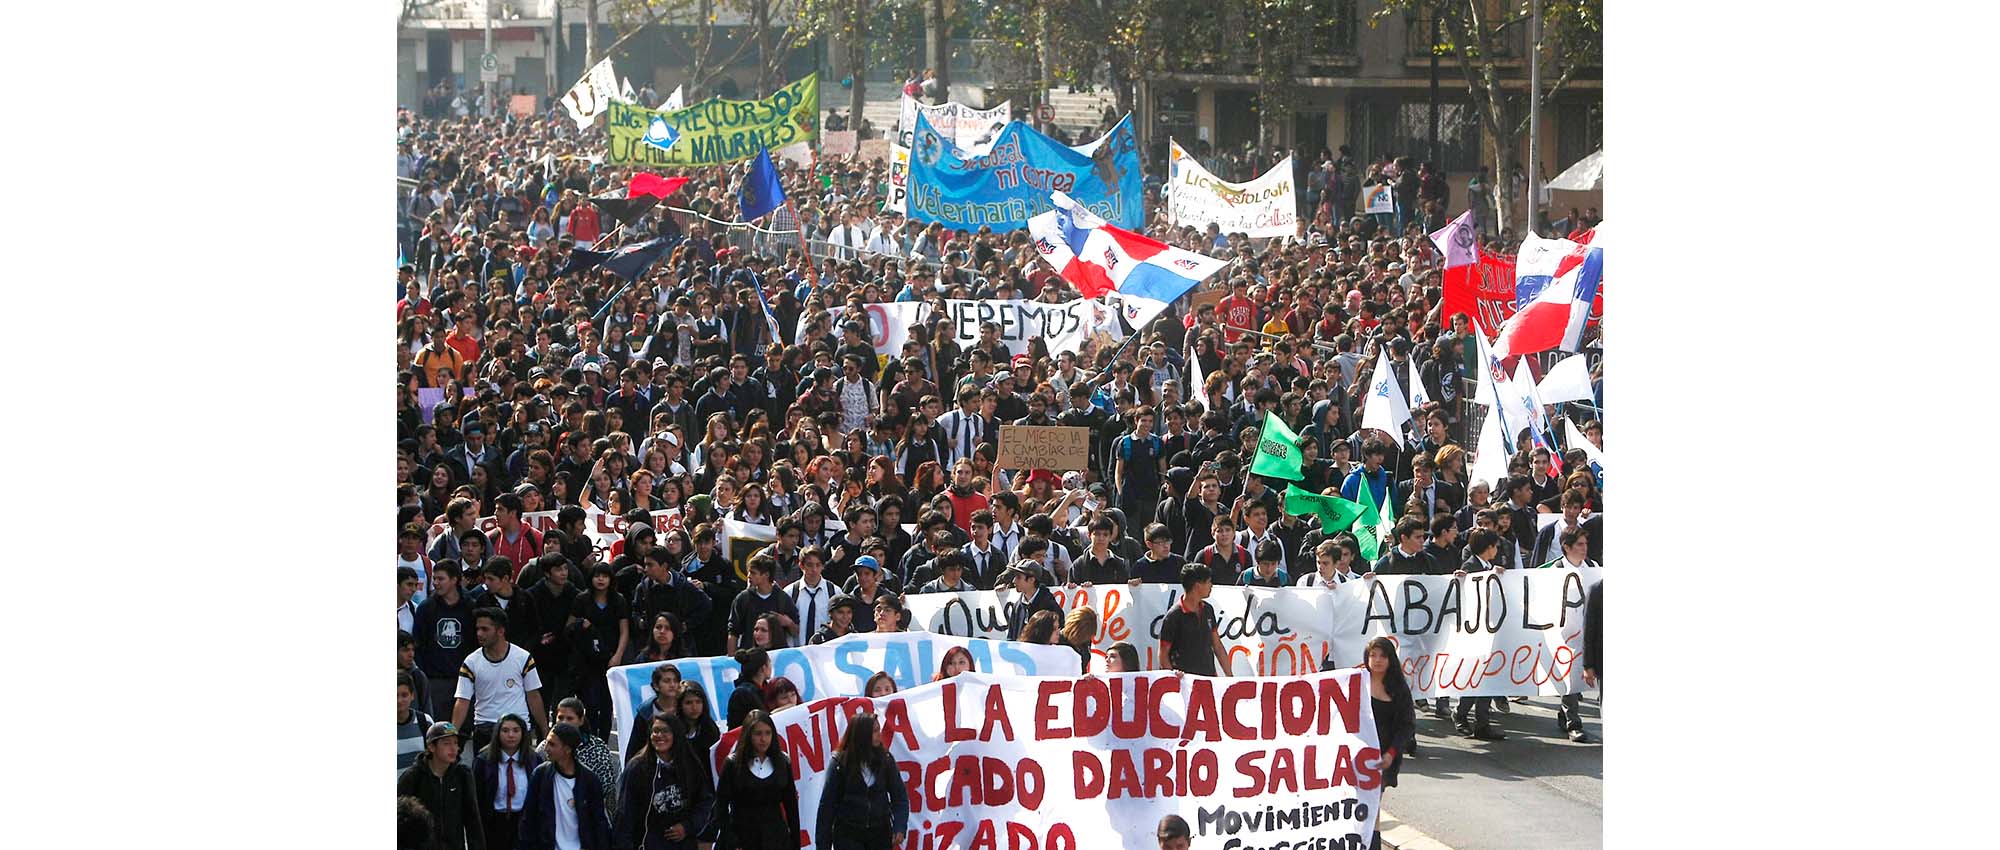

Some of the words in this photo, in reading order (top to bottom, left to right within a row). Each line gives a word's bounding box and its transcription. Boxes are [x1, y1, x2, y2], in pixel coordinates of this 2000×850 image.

[672, 82, 803, 132] RECURSOS
[691, 118, 796, 164] NATURALES
[912, 175, 1026, 224] Veterinaria
[1361, 573, 1508, 636] ABAJO
[1522, 571, 1586, 631] LA
[942, 683, 1014, 743] LA
[1034, 676, 1363, 743] EDUCACION
[1073, 739, 1219, 801] DARÍO
[1232, 744, 1383, 800] SALAS
